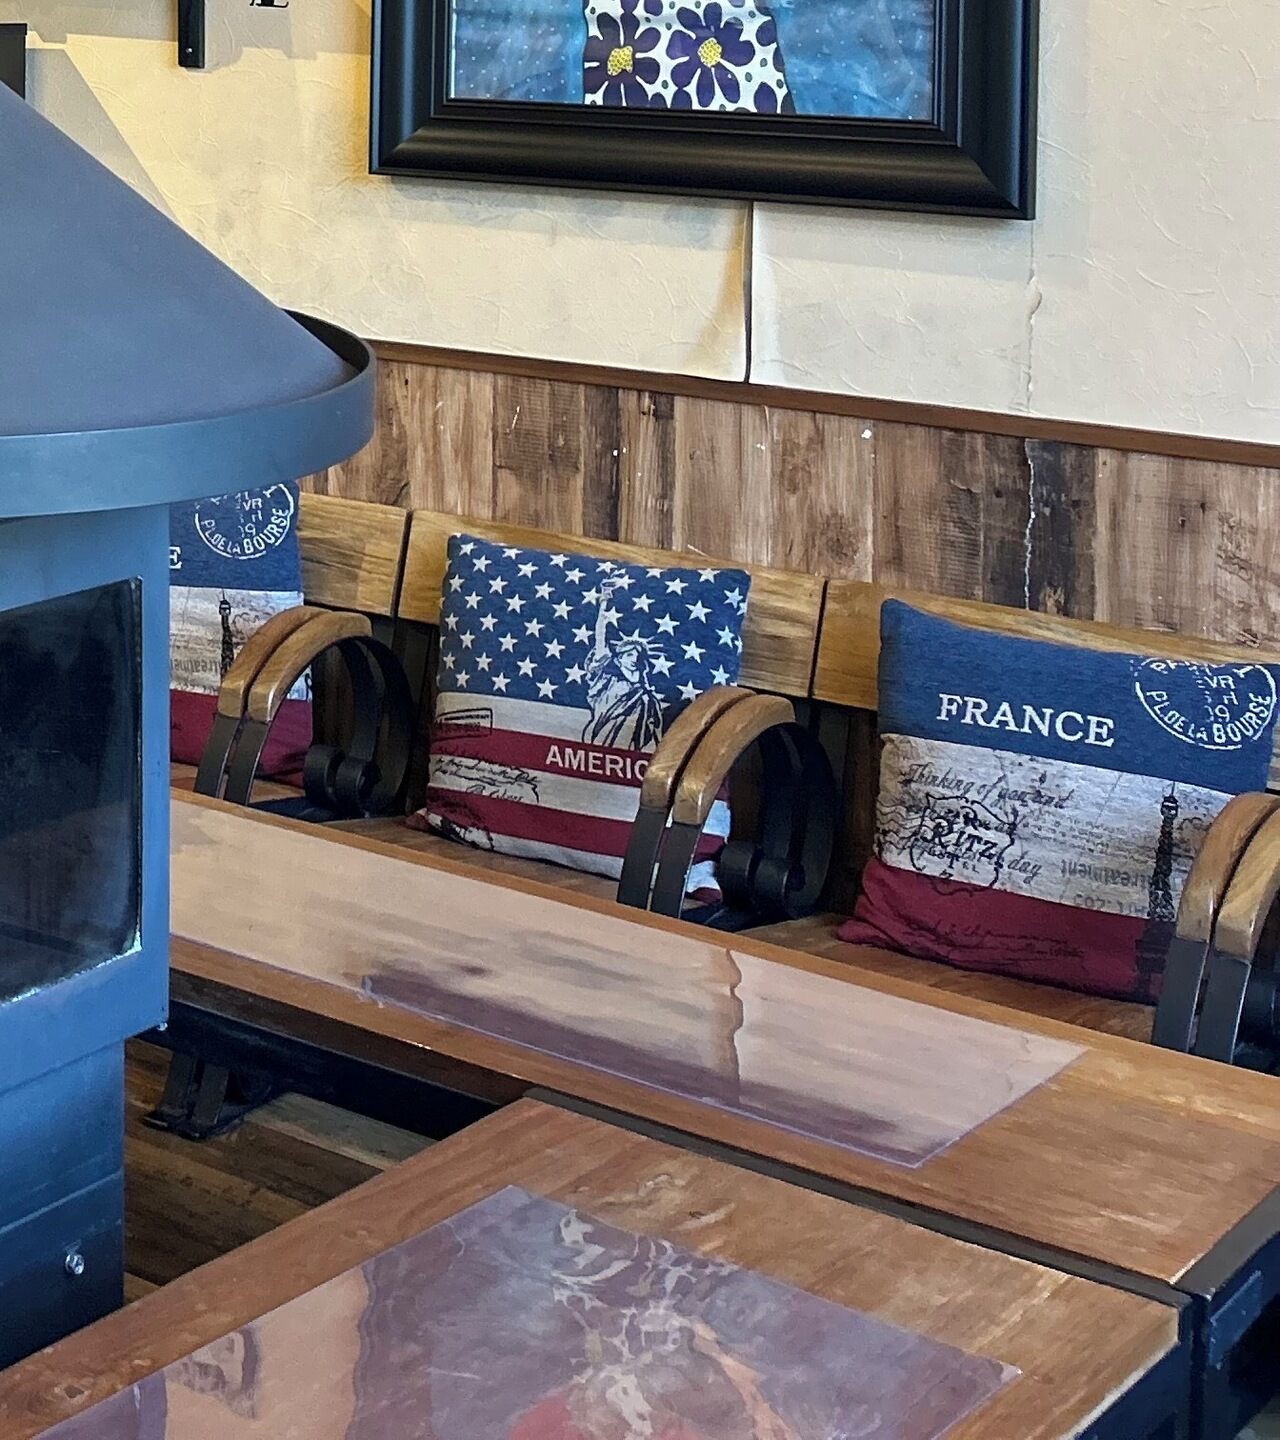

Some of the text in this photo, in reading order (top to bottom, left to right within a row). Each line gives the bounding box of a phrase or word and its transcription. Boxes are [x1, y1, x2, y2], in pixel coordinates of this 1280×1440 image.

[243, 508, 289, 554] BOURSE
[936, 693, 1115, 748] FRANCE
[1212, 693, 1272, 744] BOURSE
[545, 744, 651, 782] AMERIC
[909, 761, 976, 799] Thinking
[920, 815, 999, 861] RITZ
[1007, 853, 1043, 885] day
